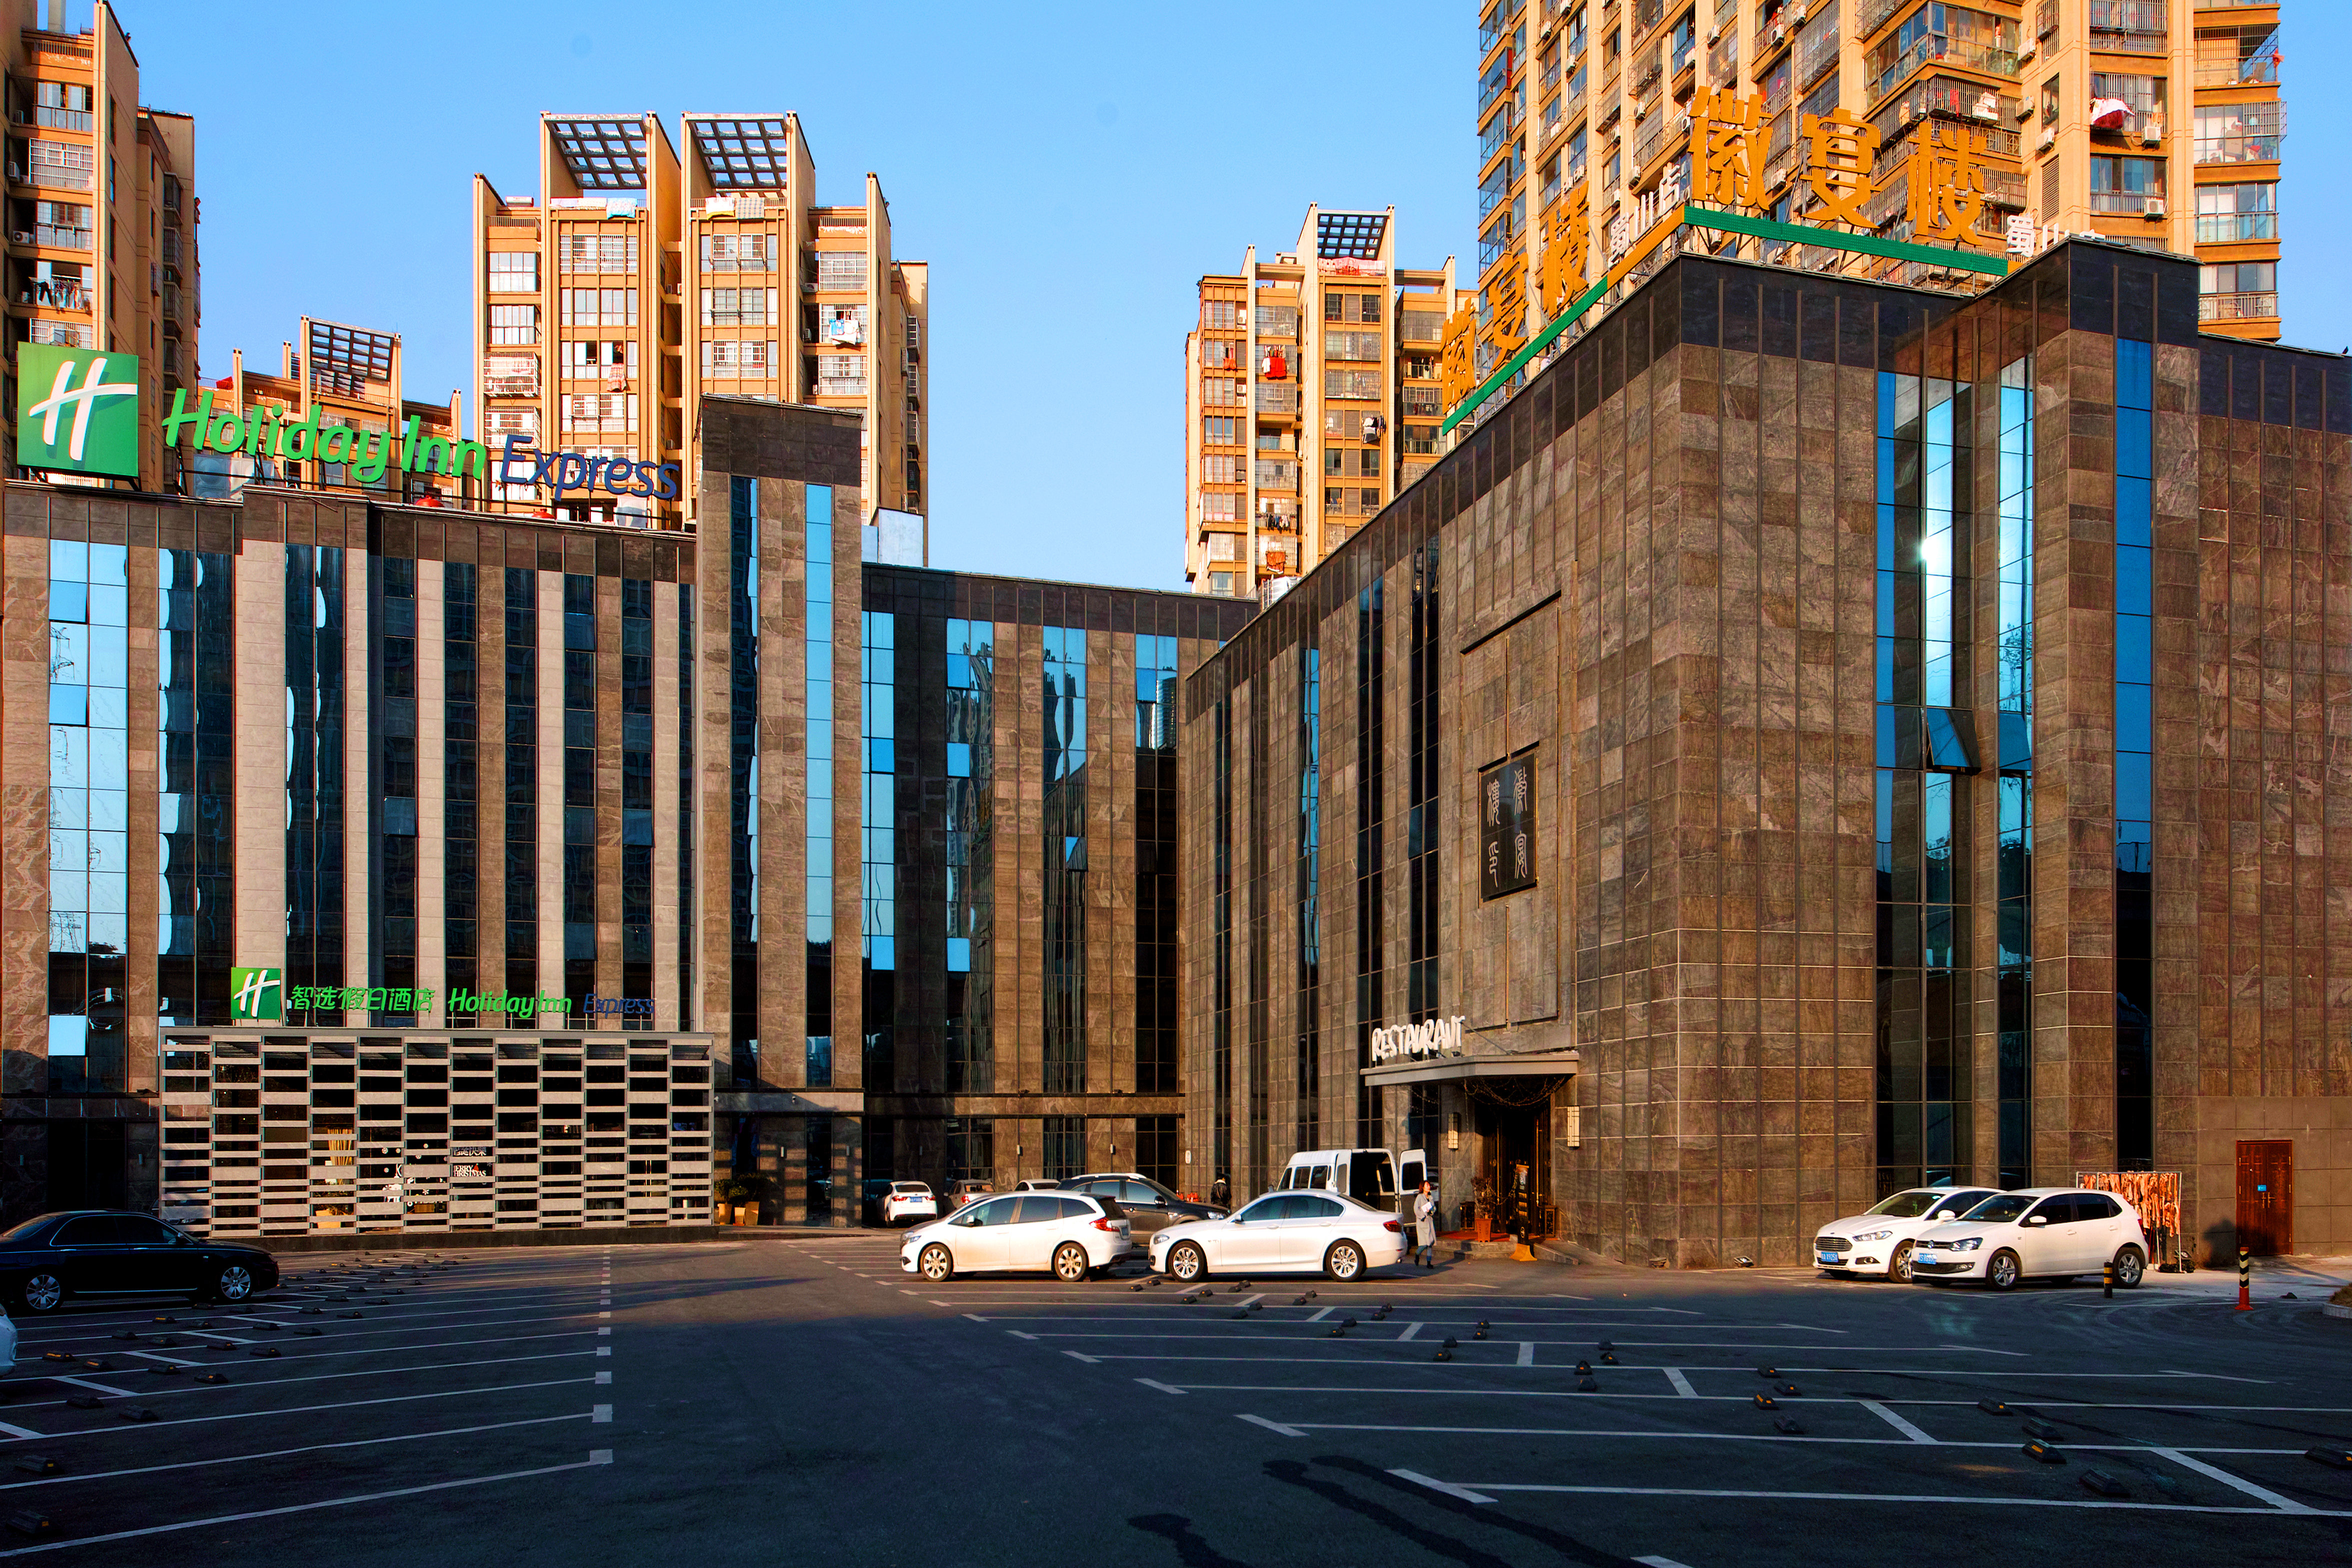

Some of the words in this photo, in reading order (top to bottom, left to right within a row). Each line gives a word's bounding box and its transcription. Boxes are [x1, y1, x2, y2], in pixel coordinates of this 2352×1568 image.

[1608, 165, 1680, 268] 蜀山店
[162, 388, 392, 482] Holiday
[400, 415, 487, 480] Inn
[500, 434, 679, 501] Express
[290, 984, 436, 1012] 智选假日酒店
[448, 988, 534, 1018] Holiday
[538, 990, 572, 1014] Inn
[583, 993, 655, 1018] Express
[1372, 1016, 1466, 1062] RESTAURANT
